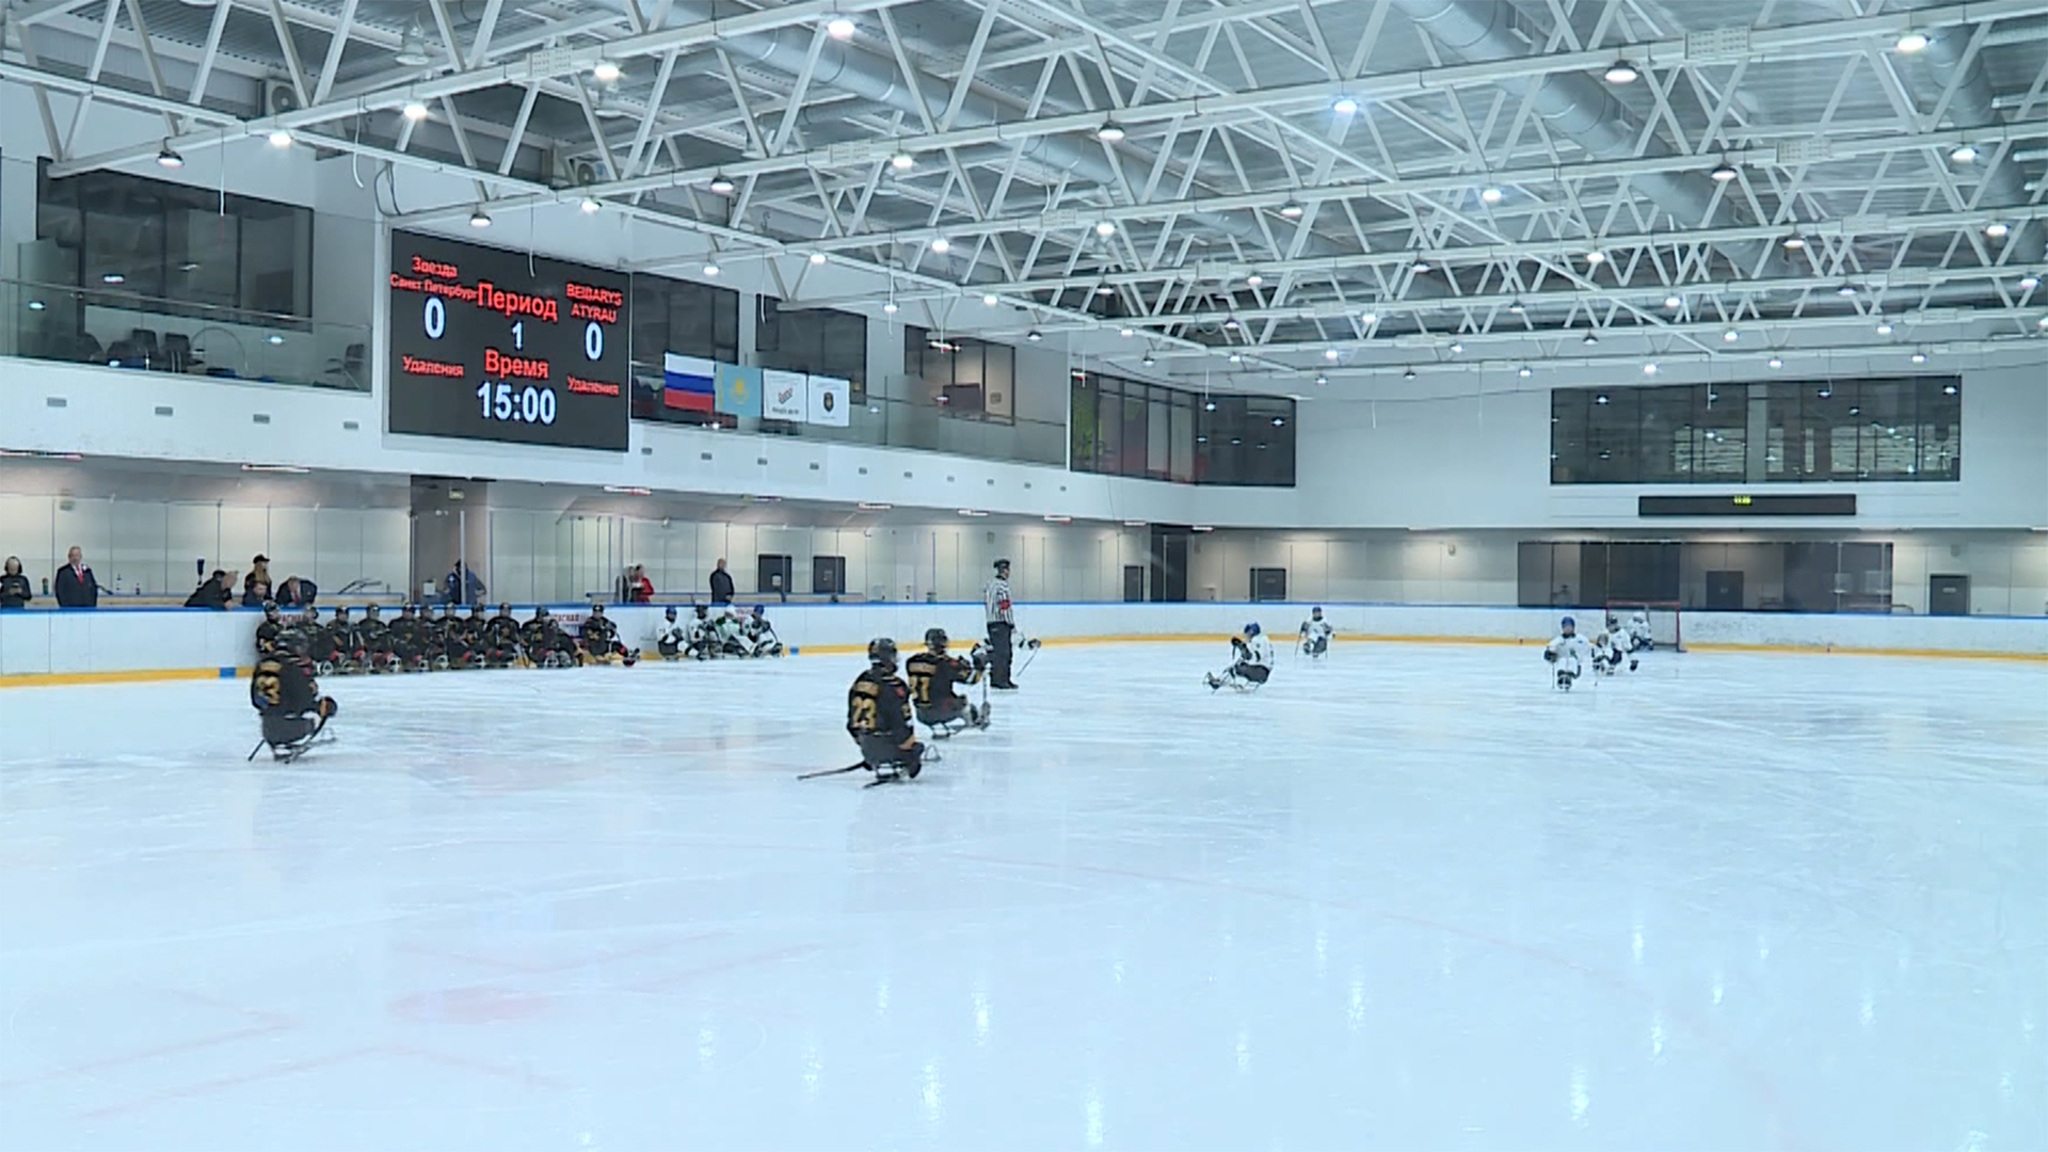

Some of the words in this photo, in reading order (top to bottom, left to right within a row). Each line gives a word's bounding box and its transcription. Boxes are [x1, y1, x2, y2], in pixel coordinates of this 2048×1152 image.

[412, 255, 457, 278] Звезда
[478, 281, 557, 321] Период
[571, 303, 617, 322] ATYRAU
[424, 297, 445, 338] 0
[511, 321, 523, 348] 1
[585, 322, 603, 360] 0
[403, 356, 464, 376] Удаления
[485, 350, 549, 379] Время
[477, 381, 556, 424] 15:00
[852, 697, 876, 728] 23
